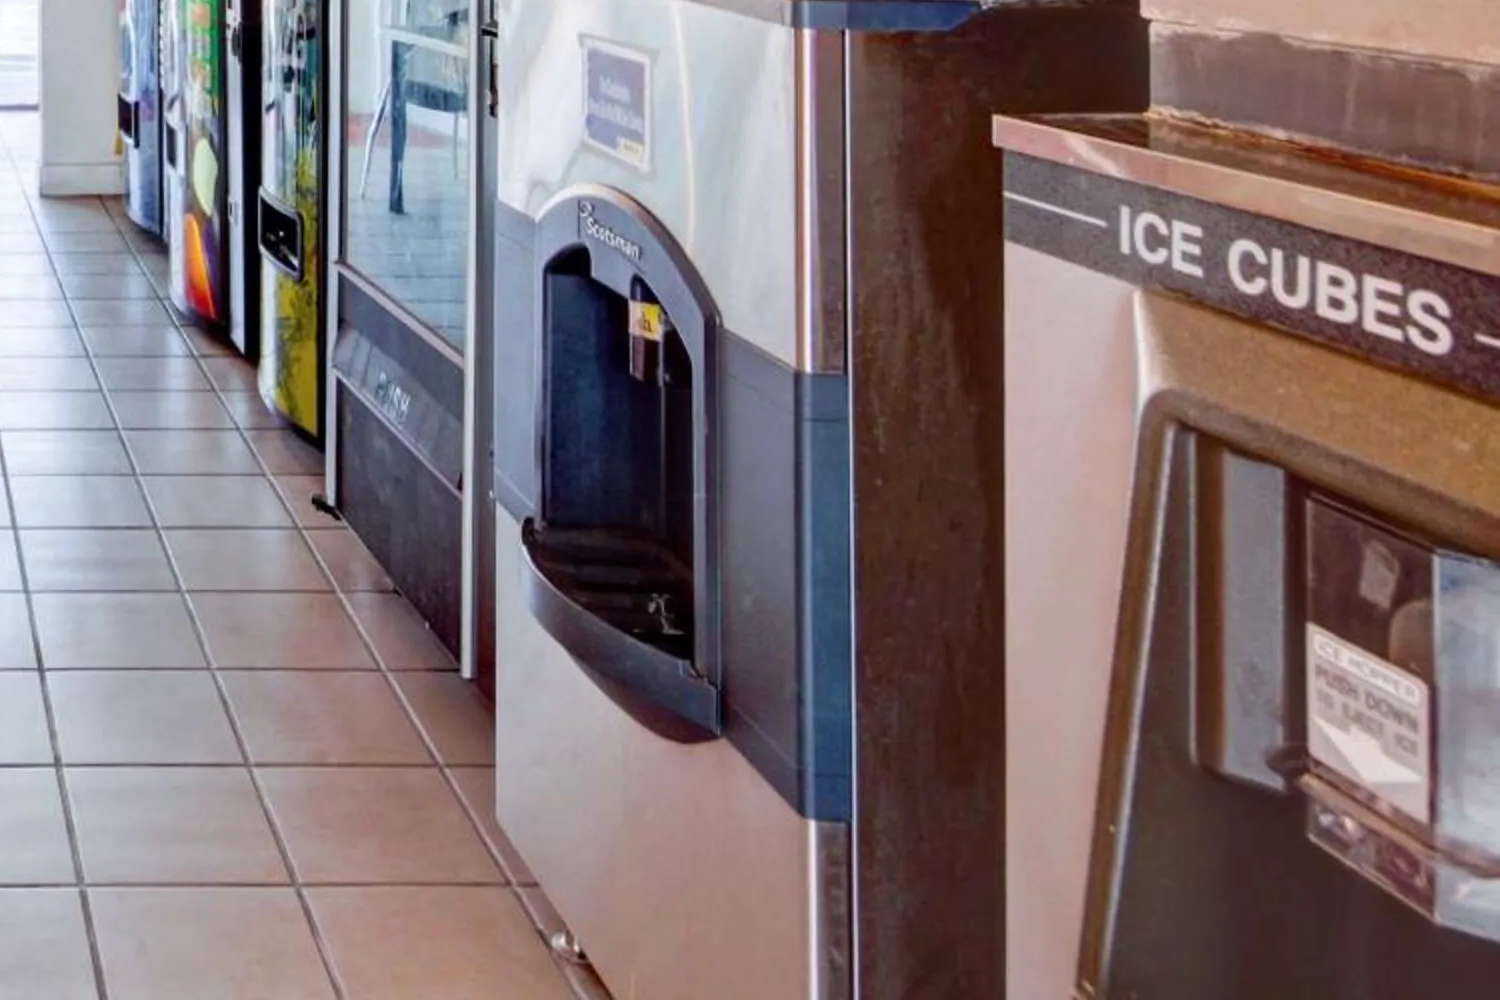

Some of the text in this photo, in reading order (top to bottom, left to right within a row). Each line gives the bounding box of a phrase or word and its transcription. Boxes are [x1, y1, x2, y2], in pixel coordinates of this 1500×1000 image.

[586, 216, 639, 260] Scotsman
[1118, 205, 1455, 357] ICE CUBES
[1363, 688, 1420, 736] DOWN
